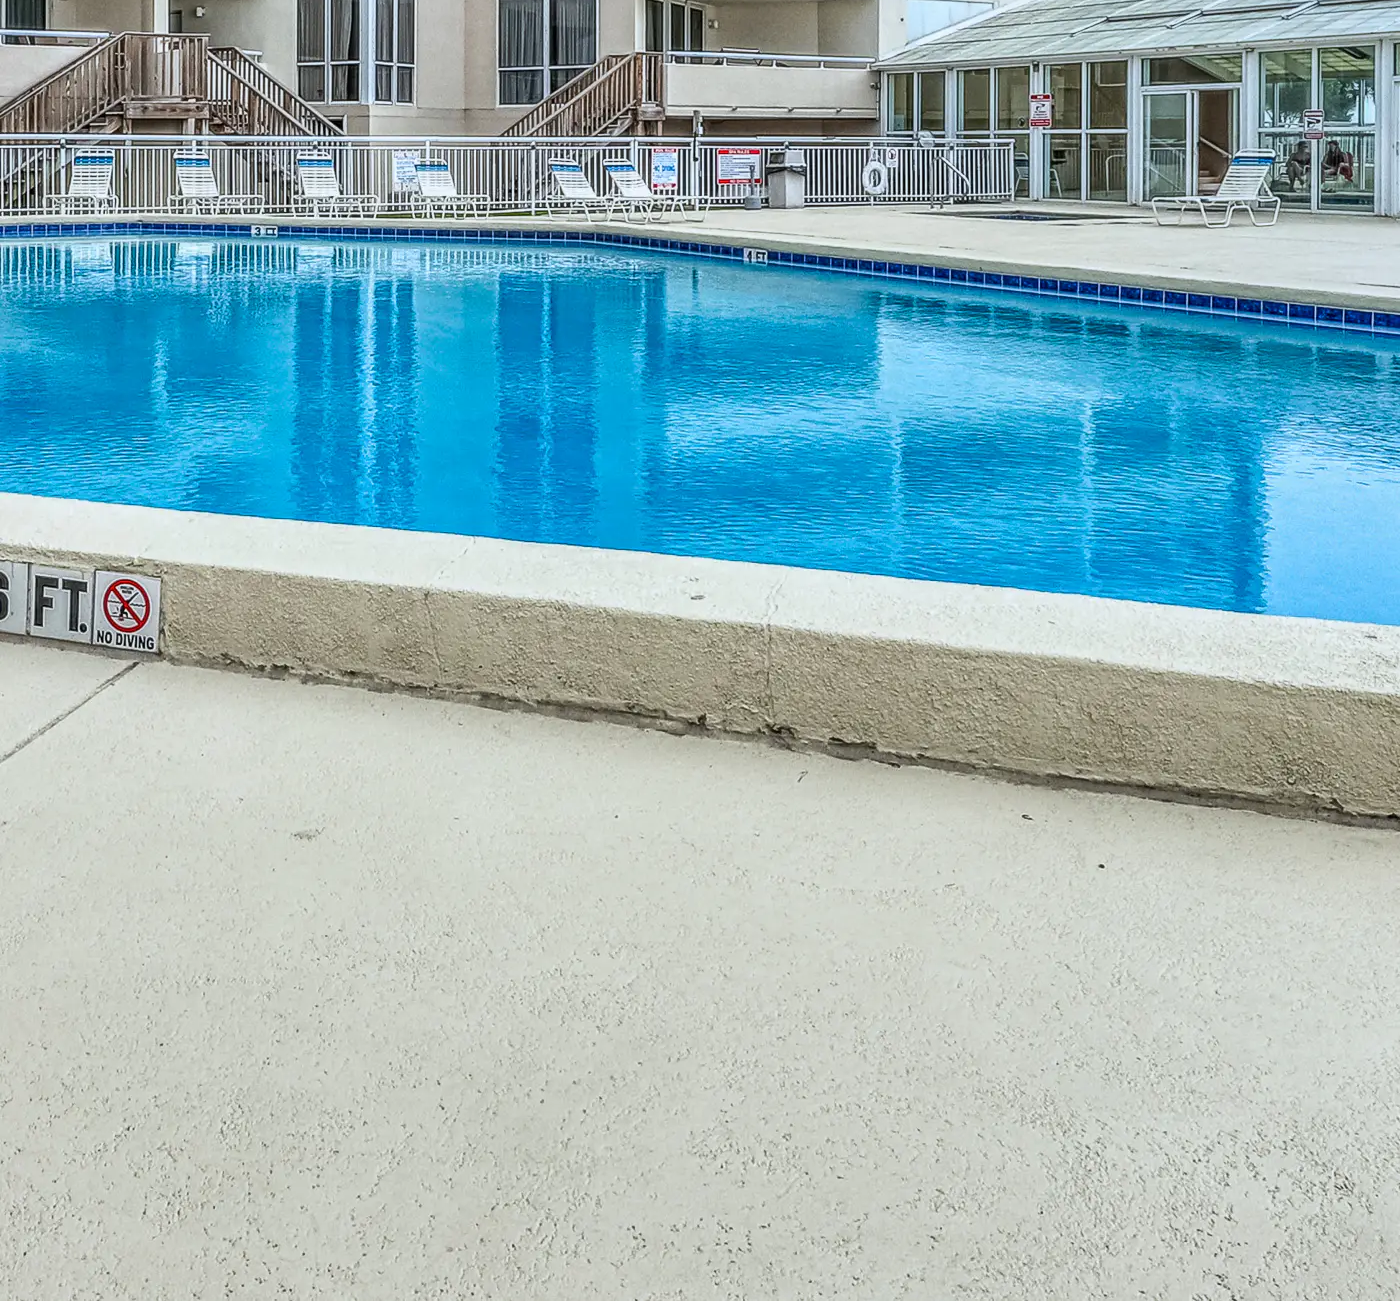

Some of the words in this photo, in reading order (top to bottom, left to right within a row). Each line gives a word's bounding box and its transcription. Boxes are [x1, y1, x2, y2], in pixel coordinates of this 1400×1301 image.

[33, 575, 88, 633] FT.
[96, 630, 113, 644] NO
[115, 633, 155, 650] DIVING
